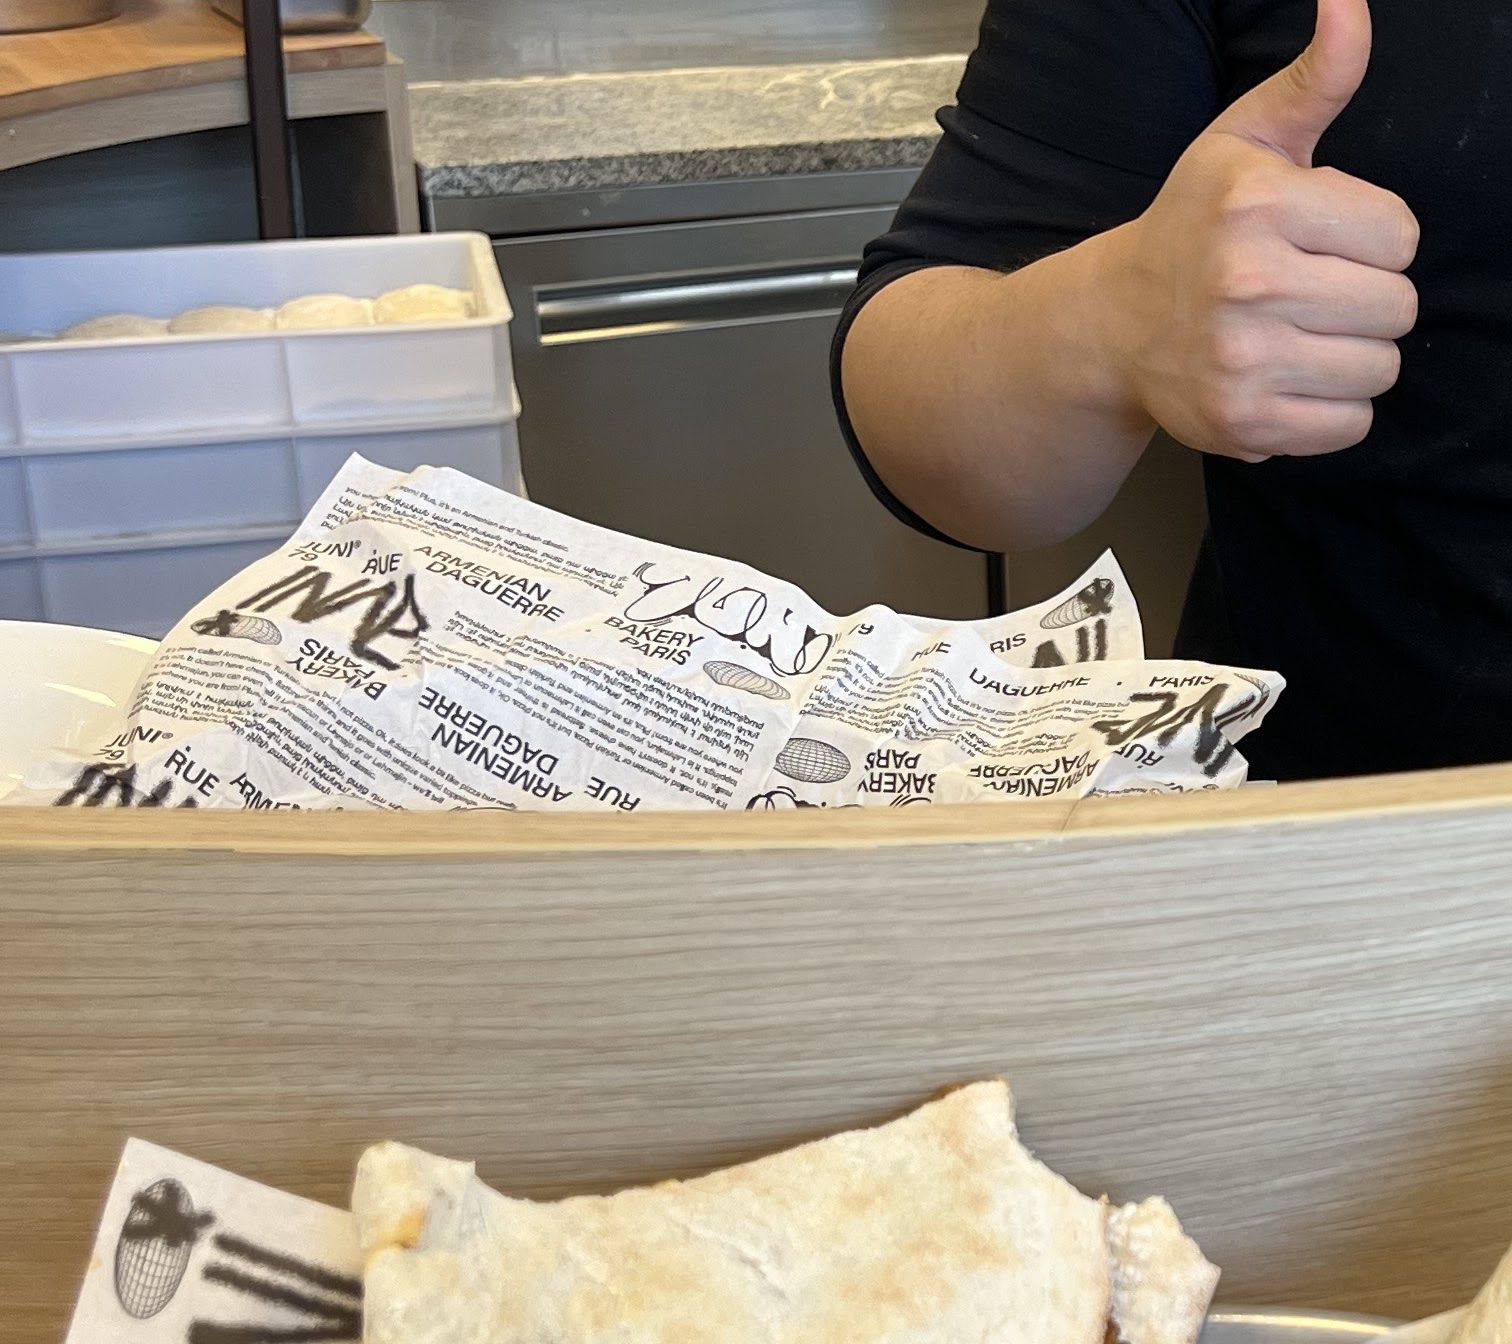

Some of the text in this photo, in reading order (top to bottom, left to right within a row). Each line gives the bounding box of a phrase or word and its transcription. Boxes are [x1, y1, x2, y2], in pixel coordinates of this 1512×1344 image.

[361, 553, 403, 575] RUE
[413, 546, 552, 602] ARMENIAN
[426, 561, 565, 622] DAGUERRE
[604, 616, 705, 648] BAKERY
[620, 637, 691, 666] PARIS
[300, 638, 375, 678] PARIS
[418, 686, 559, 776] DAGUERRE
[164, 749, 220, 797] RUE
[431, 722, 573, 802] ARMENIAN
[584, 776, 641, 811] RUE
